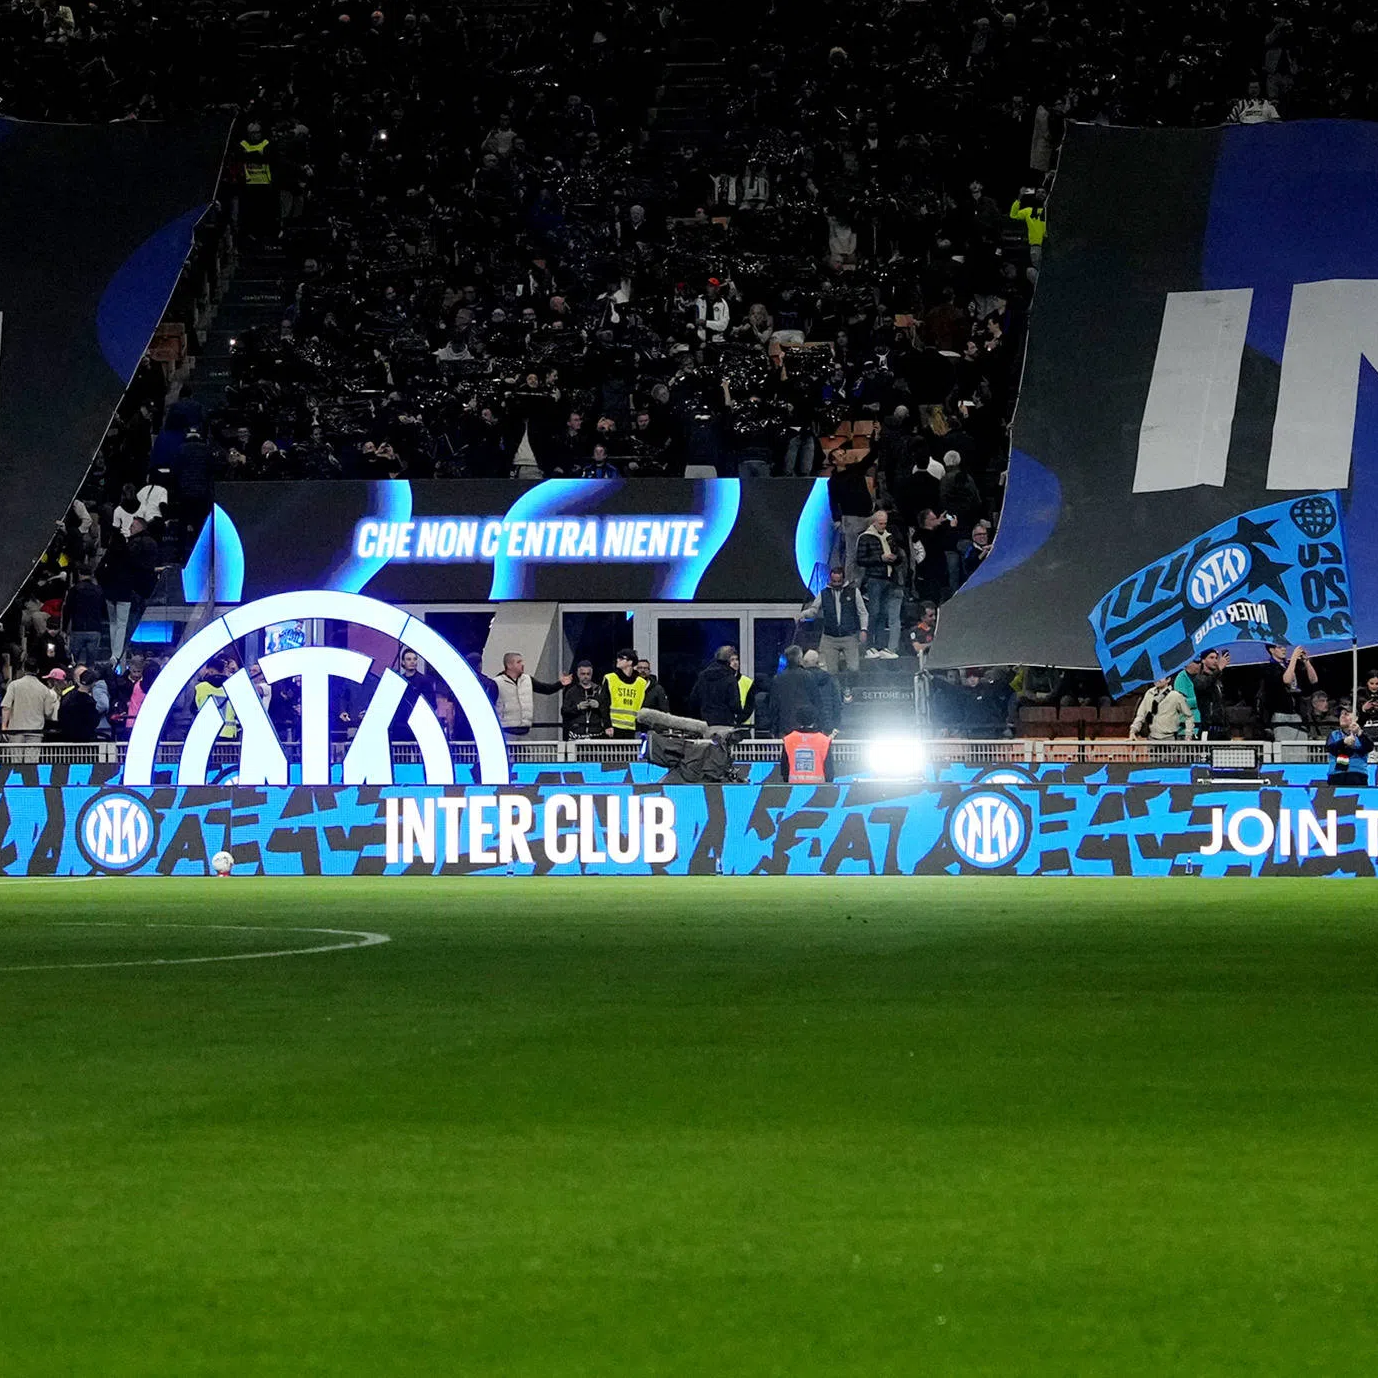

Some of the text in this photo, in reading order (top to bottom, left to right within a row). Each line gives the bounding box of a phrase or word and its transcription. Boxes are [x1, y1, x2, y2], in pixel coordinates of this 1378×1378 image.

[357, 520, 704, 558] CHE NON C'ENTRA NIENTE
[617, 687, 637, 698] STAFF
[385, 795, 678, 864] INTER CLUB
[1200, 806, 1338, 858] JOIN
